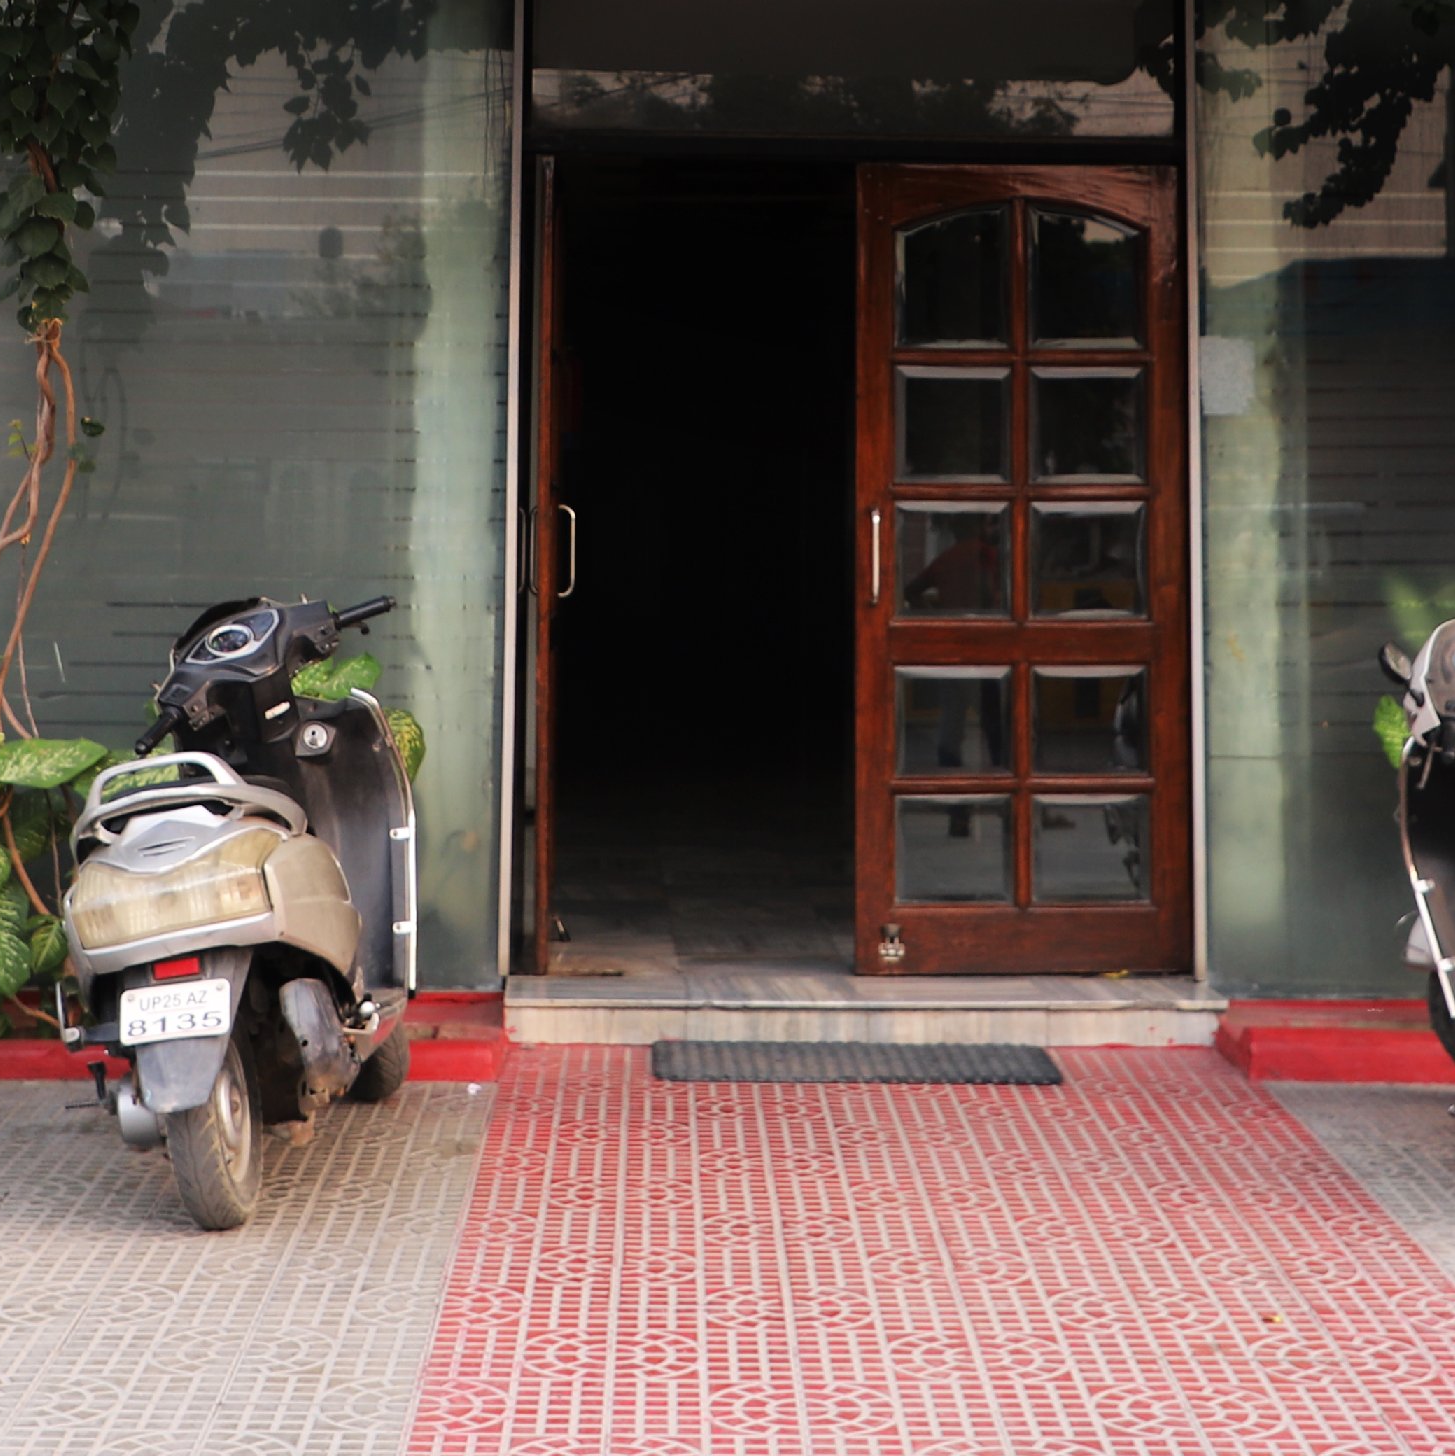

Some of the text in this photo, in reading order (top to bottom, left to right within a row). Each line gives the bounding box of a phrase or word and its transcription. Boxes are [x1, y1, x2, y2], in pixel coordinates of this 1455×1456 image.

[139, 990, 207, 1012] UP25 AZ
[128, 1011, 222, 1037] 8135
